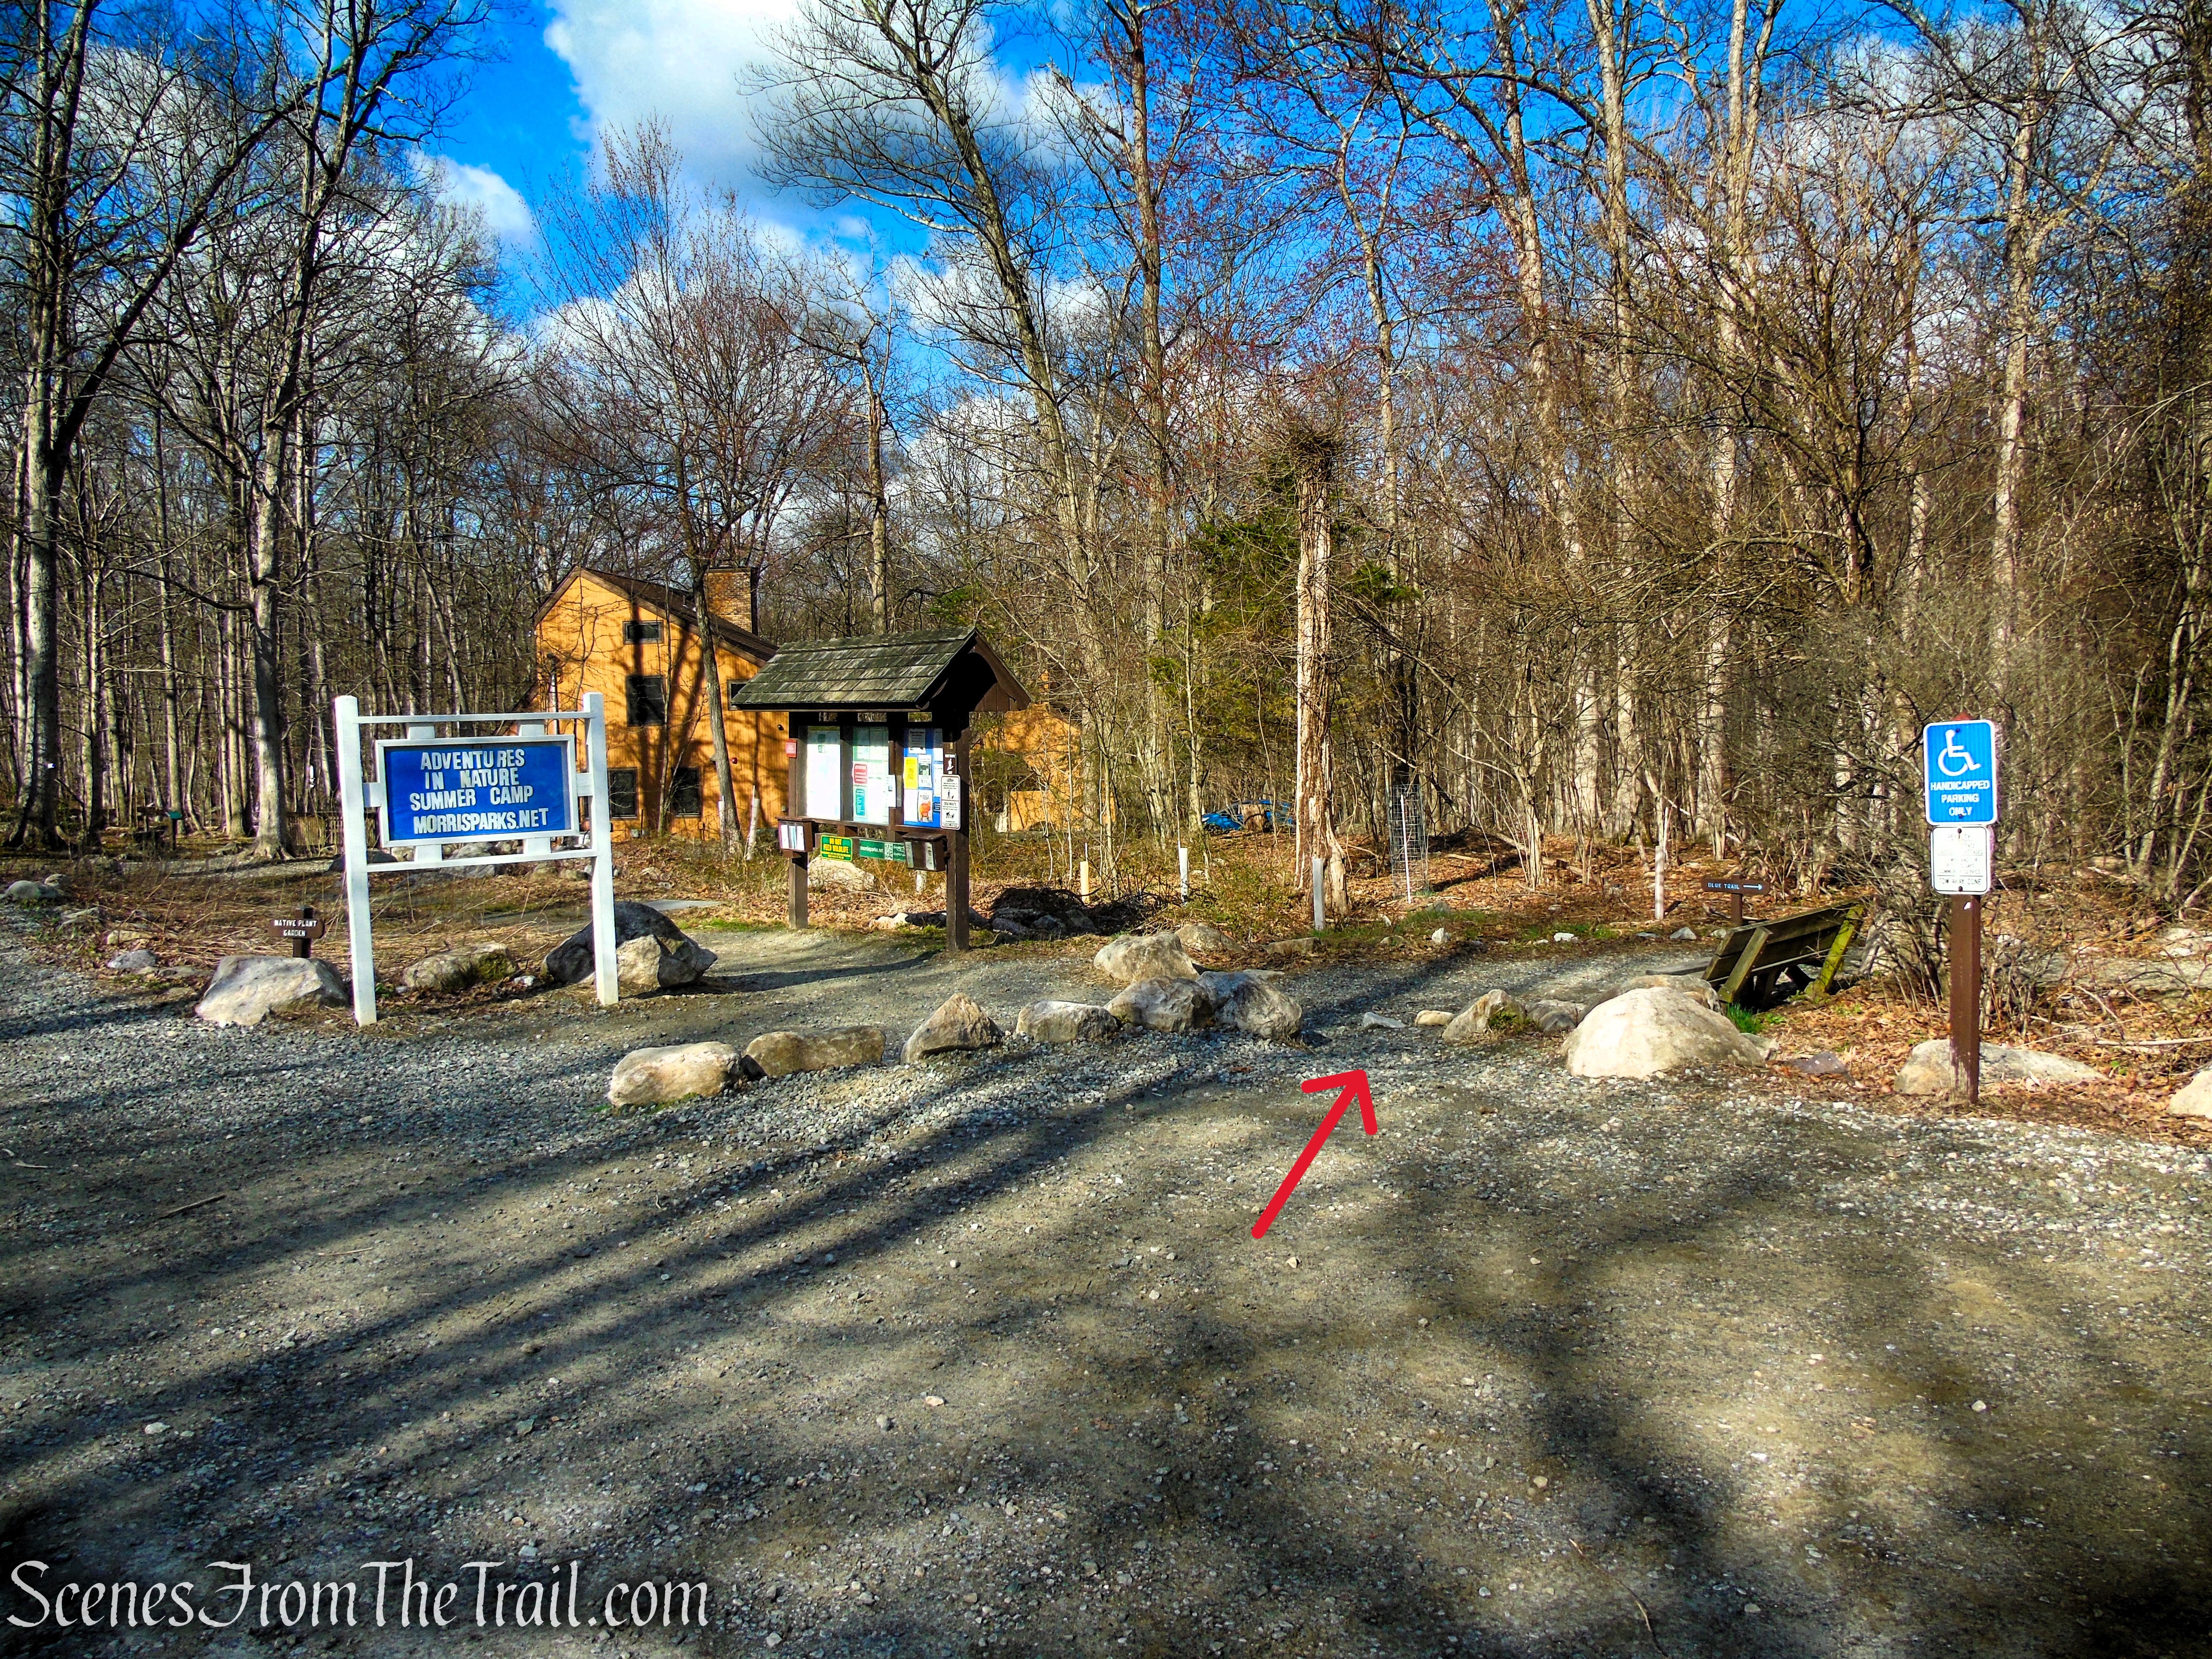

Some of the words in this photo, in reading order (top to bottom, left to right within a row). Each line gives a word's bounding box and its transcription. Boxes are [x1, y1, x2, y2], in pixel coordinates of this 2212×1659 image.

[421, 749, 525, 770] ADVENTURES
[425, 772, 444, 790] IN
[459, 768, 520, 788] NATURE
[1930, 780, 1990, 790] HANDICAPPED
[410, 789, 476, 811] SUMMER
[489, 786, 533, 805] CAMP
[1941, 793, 1980, 803] PARKING
[1948, 806, 1972, 816] ONLY
[413, 808, 548, 834] MORRISPARKS.NET
[833, 845, 849, 853] WILDLIFE
